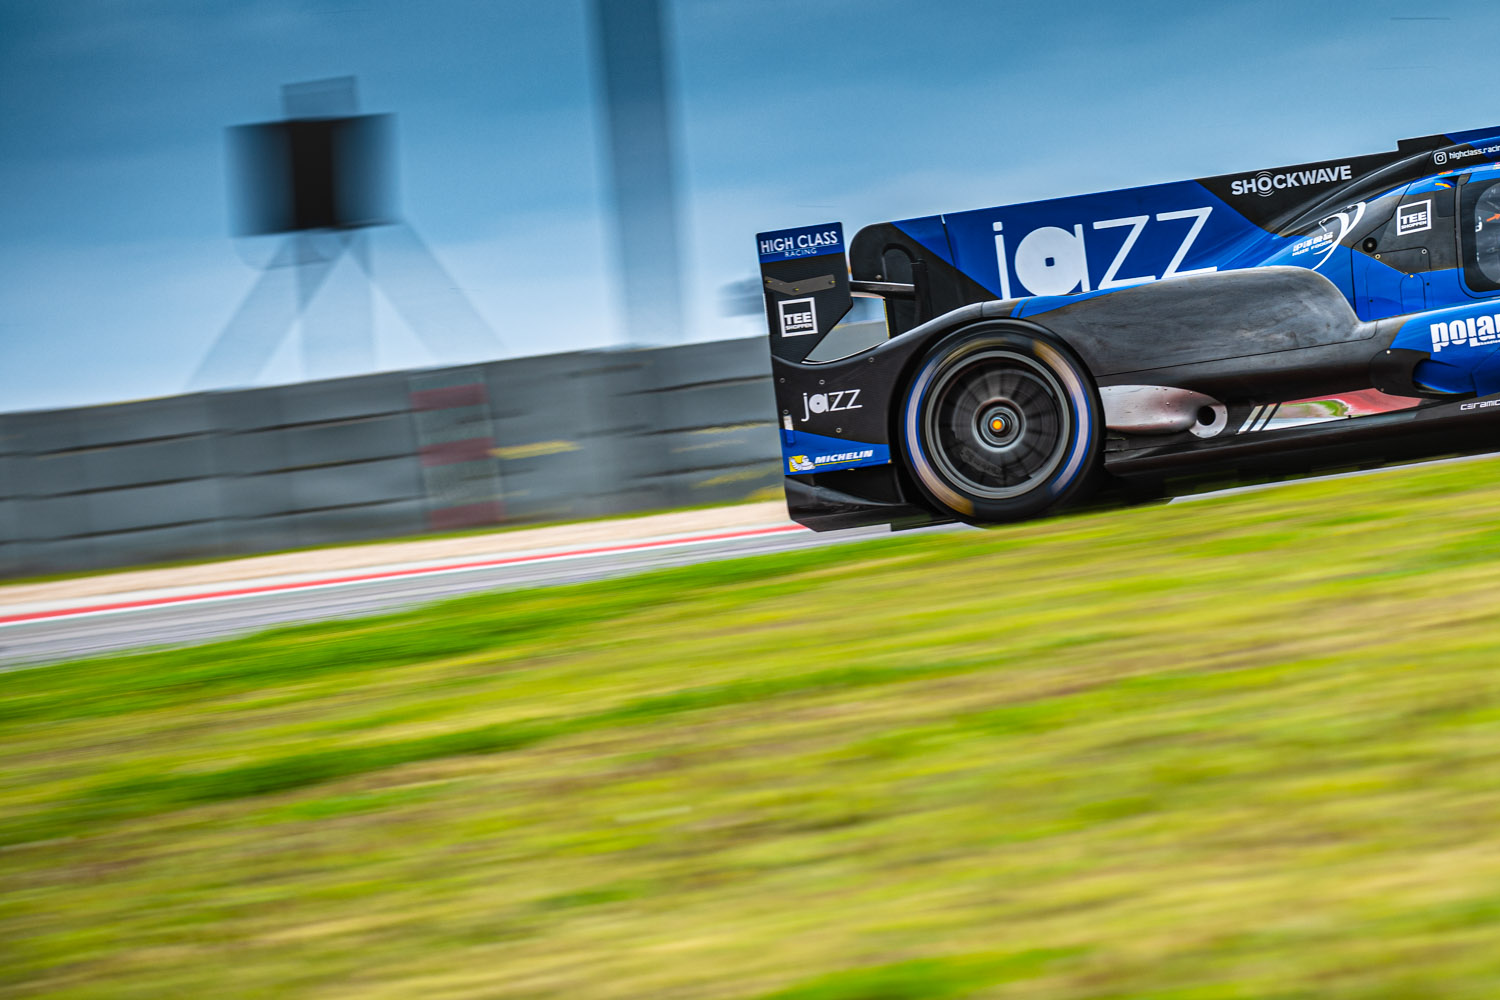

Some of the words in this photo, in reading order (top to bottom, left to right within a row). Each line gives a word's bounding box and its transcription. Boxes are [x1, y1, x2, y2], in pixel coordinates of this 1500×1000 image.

[1231, 165, 1352, 195] SHOCKWAVE
[1401, 211, 1427, 225] TEE
[760, 237, 796, 253] HIGH
[797, 231, 839, 248] CLASS
[784, 247, 817, 258] RACING
[993, 206, 1218, 300] jazz
[784, 312, 813, 325] TEE
[801, 388, 863, 422] jazz
[815, 449, 874, 464] MICHELIN
